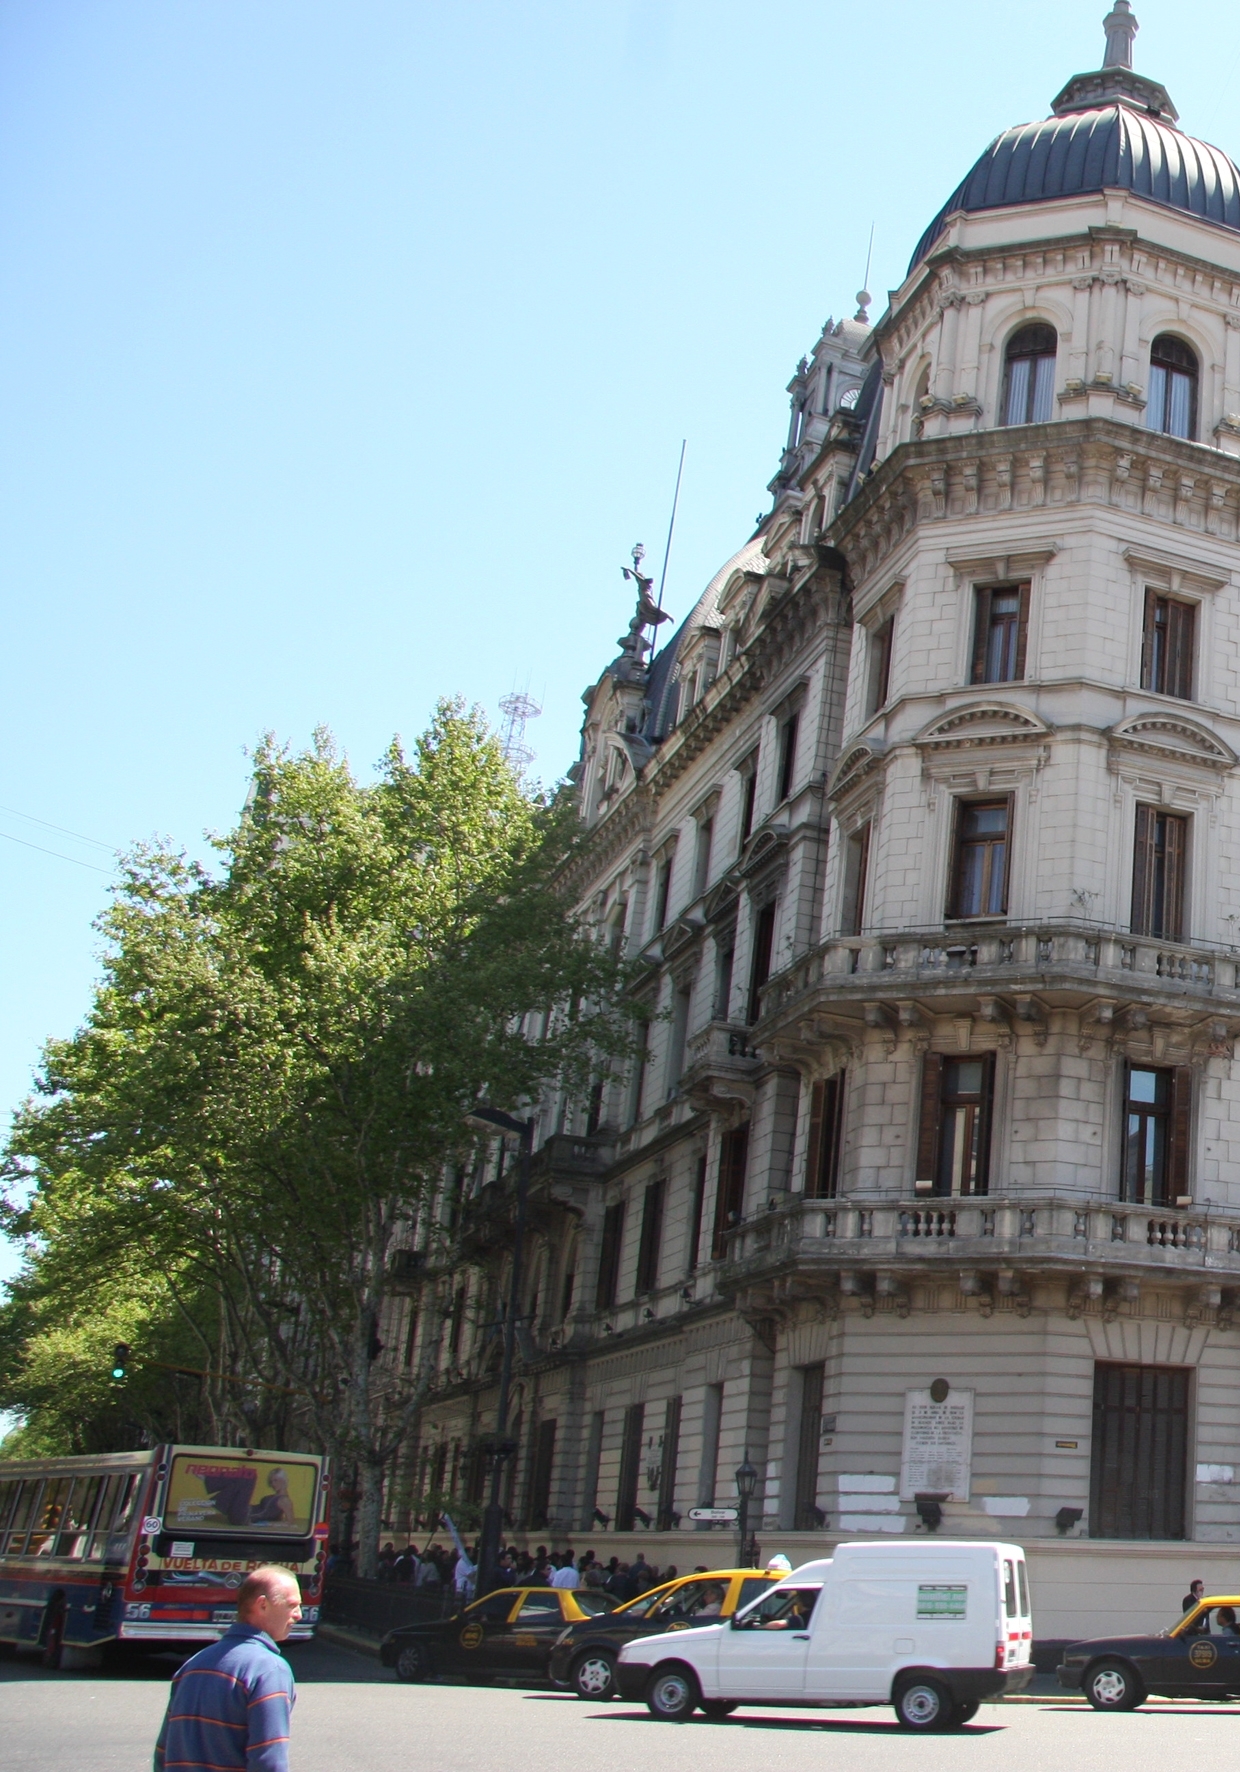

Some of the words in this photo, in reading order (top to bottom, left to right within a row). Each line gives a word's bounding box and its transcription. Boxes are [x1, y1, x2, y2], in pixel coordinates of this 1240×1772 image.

[146, 1520, 159, 1529] 60
[163, 1558, 219, 1571] VUELTA
[221, 1561, 242, 1572] DE
[126, 1603, 152, 1619] 56
[301, 1606, 320, 1622] 56
